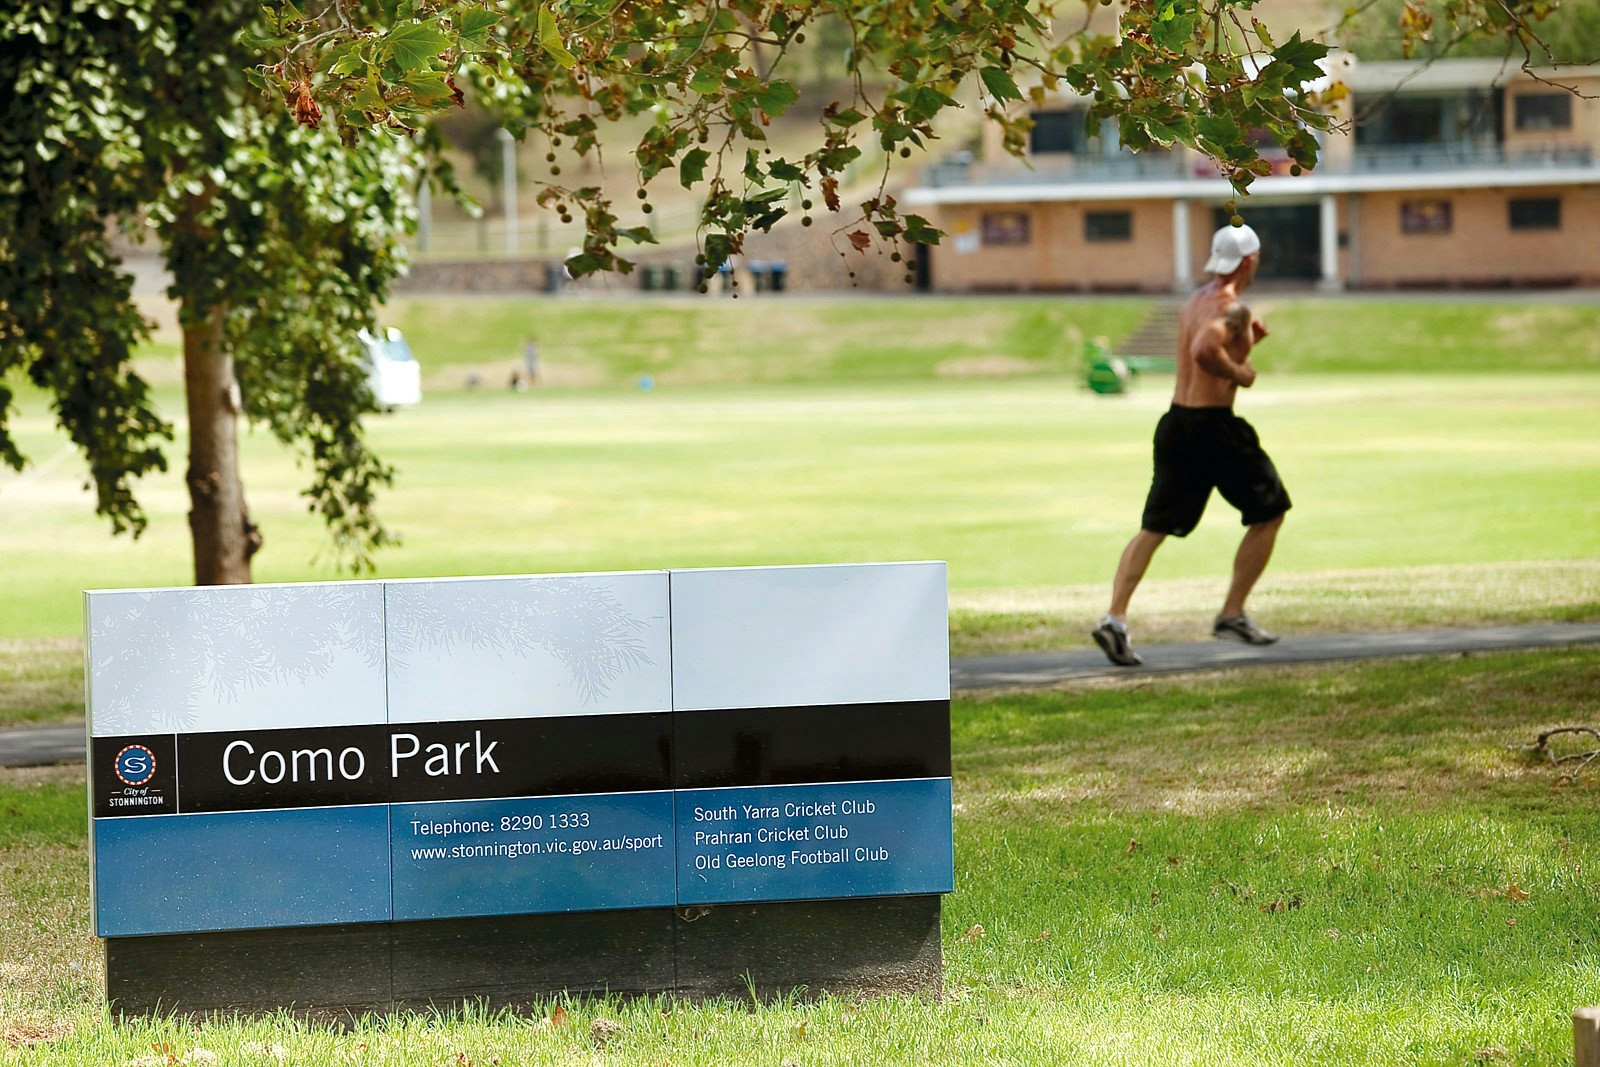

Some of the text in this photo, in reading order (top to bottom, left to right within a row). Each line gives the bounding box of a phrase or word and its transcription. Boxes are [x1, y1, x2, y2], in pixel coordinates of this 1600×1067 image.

[124, 756, 147, 774] S
[222, 729, 500, 786] Como Park
[109, 796, 164, 807] STONNINGTON
[123, 786, 149, 797] City of
[694, 800, 876, 822] South Yarra Cricket Club
[410, 812, 590, 837] Telephone: 8290 1333
[695, 825, 849, 846] Prahran Cricket Club
[410, 833, 663, 860] www.stonnington.vic.gov.au/sport
[695, 846, 889, 870] Old Geelong Football Club
